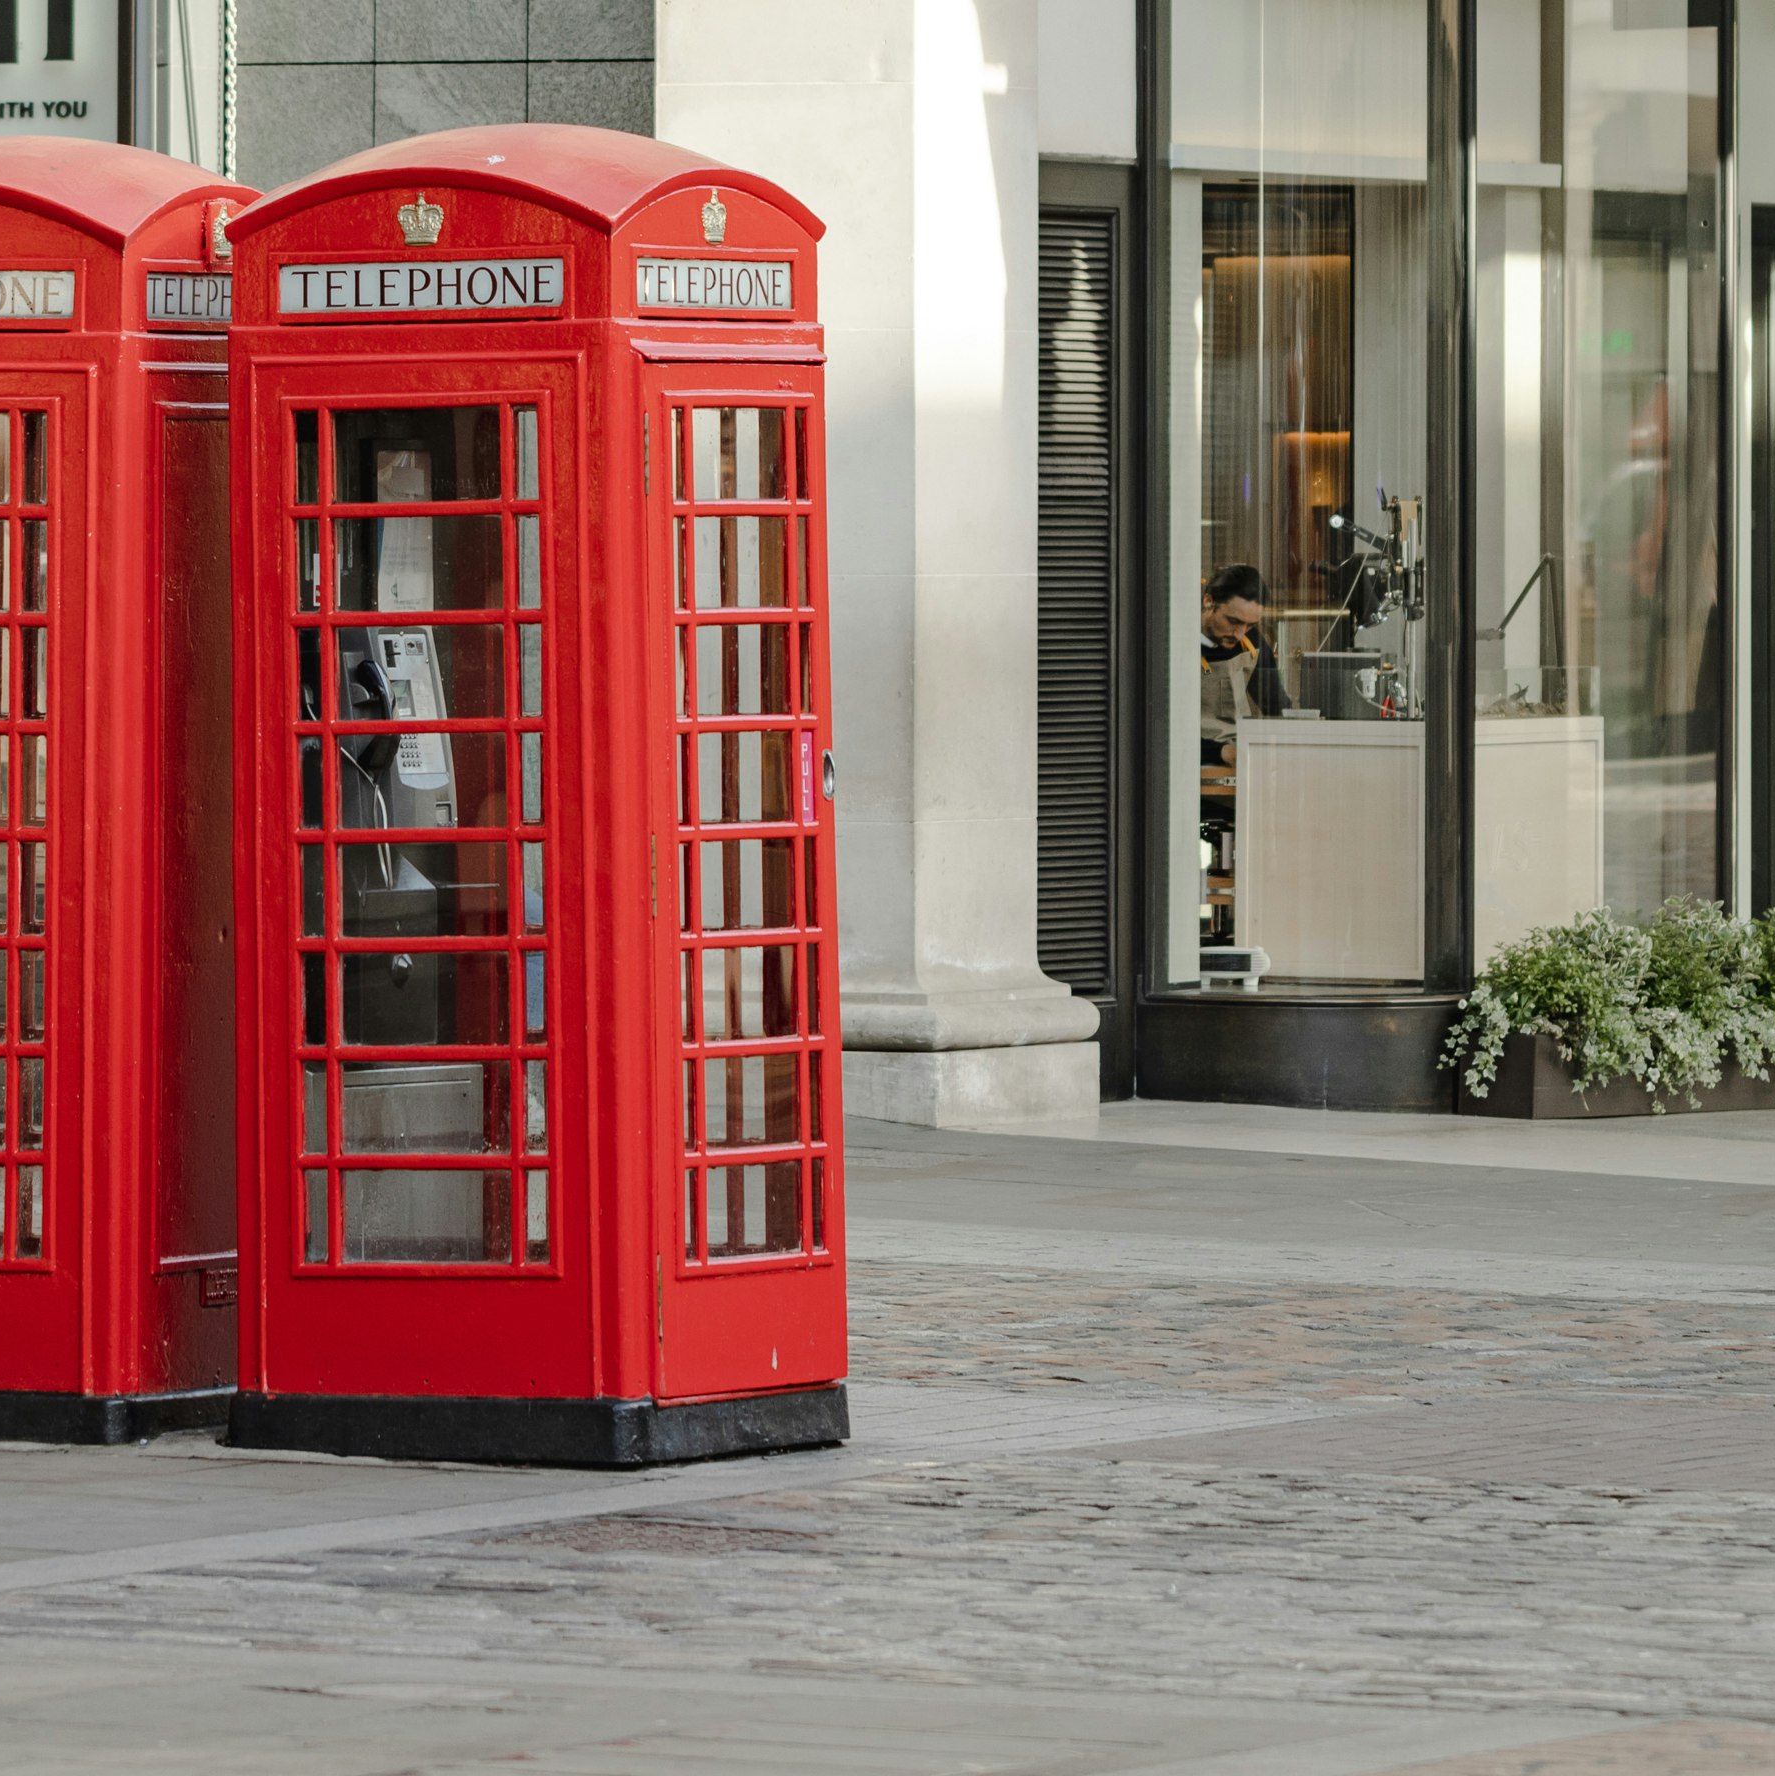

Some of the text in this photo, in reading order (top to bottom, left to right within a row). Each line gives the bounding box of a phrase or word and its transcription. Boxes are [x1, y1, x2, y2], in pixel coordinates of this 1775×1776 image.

[42, 101, 88, 118] YOU
[147, 277, 233, 317] TELEPH
[291, 265, 555, 308] TELEPHONE
[638, 265, 784, 307] TELEPHONE
